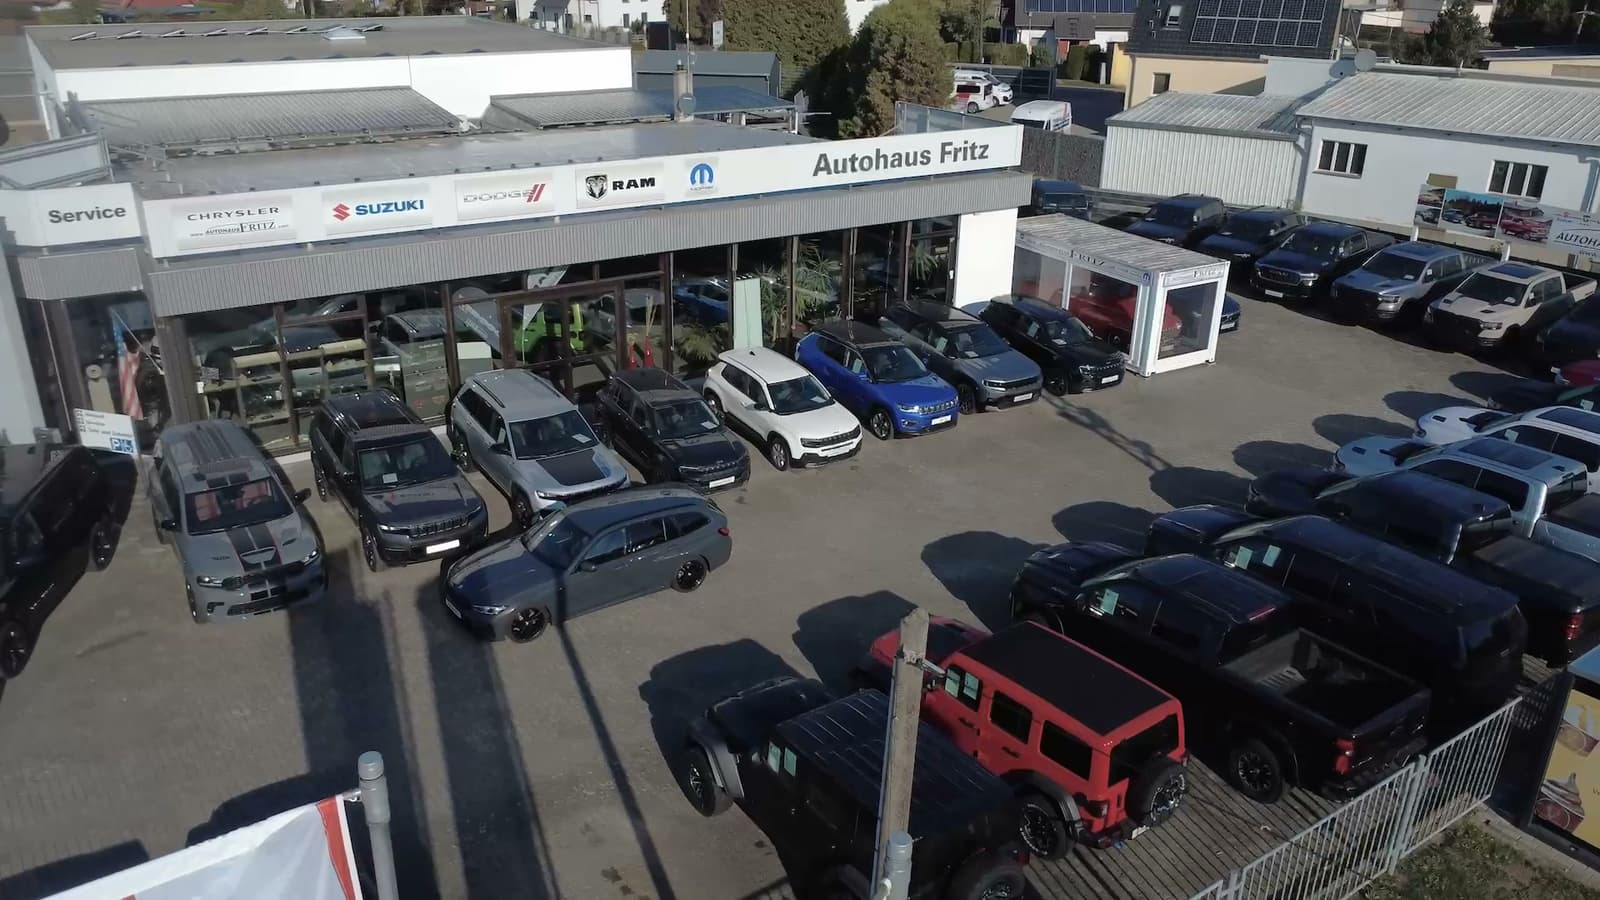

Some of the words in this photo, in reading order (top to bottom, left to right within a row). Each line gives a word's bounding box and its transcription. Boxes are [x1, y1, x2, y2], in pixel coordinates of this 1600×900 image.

[812, 148, 931, 177] Autohaus
[940, 140, 990, 164] Fritz
[612, 177, 656, 191] RAM
[48, 205, 127, 224] Service
[187, 206, 280, 221] CHRYSLER
[355, 199, 425, 216] SUZUKI
